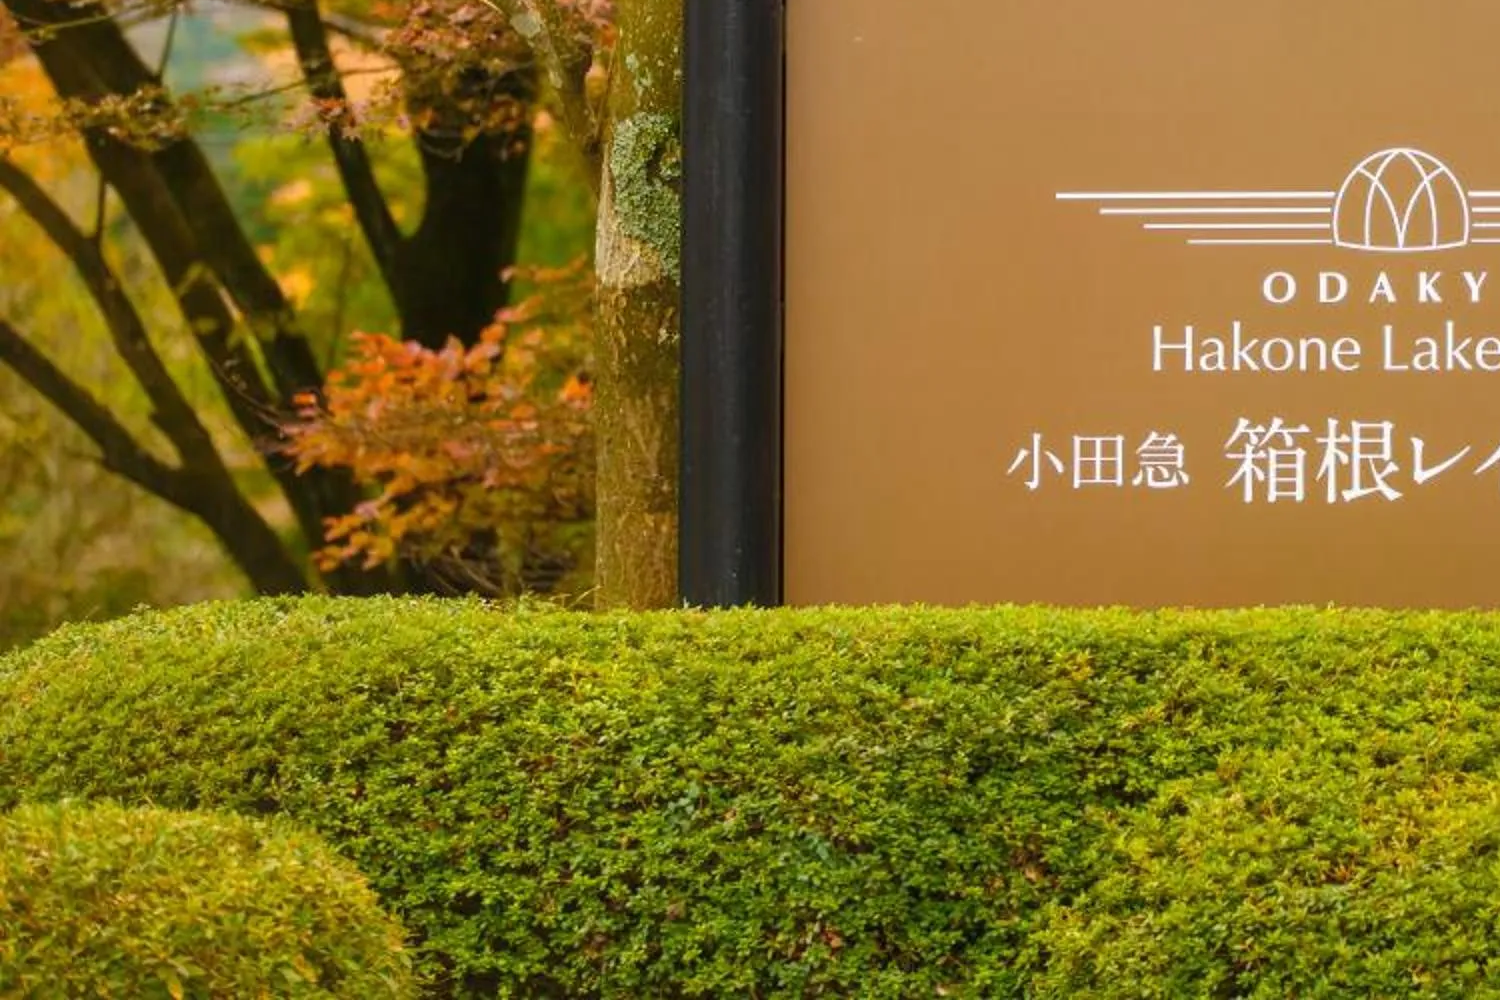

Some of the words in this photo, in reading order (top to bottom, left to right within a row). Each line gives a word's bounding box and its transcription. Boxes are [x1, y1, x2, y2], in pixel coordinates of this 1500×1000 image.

[1152, 320, 1361, 372] Hakone
[1007, 430, 1190, 490] 小田急
